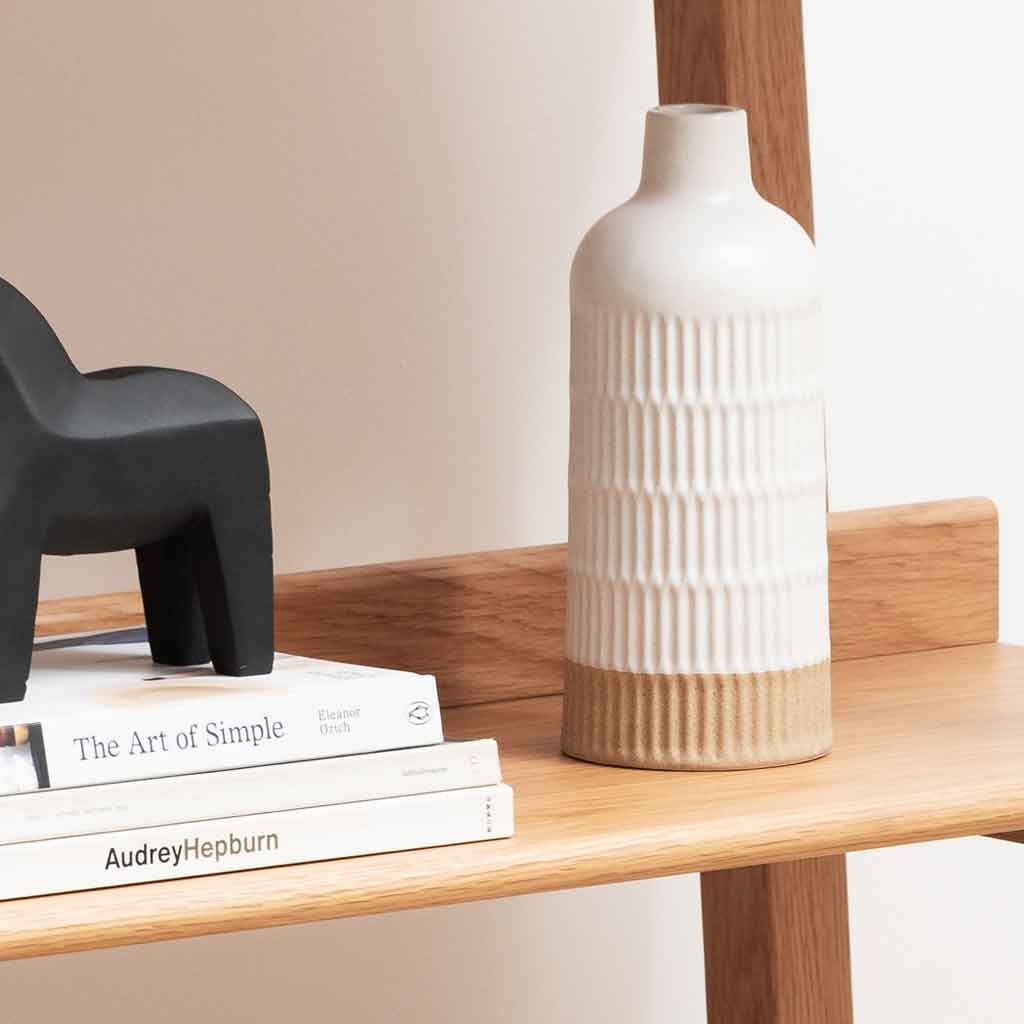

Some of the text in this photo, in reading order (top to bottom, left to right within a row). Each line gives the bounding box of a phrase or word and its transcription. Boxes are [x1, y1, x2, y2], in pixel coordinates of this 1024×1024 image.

[318, 707, 361, 721] Eleanor
[73, 716, 285, 760] The Art of Simple
